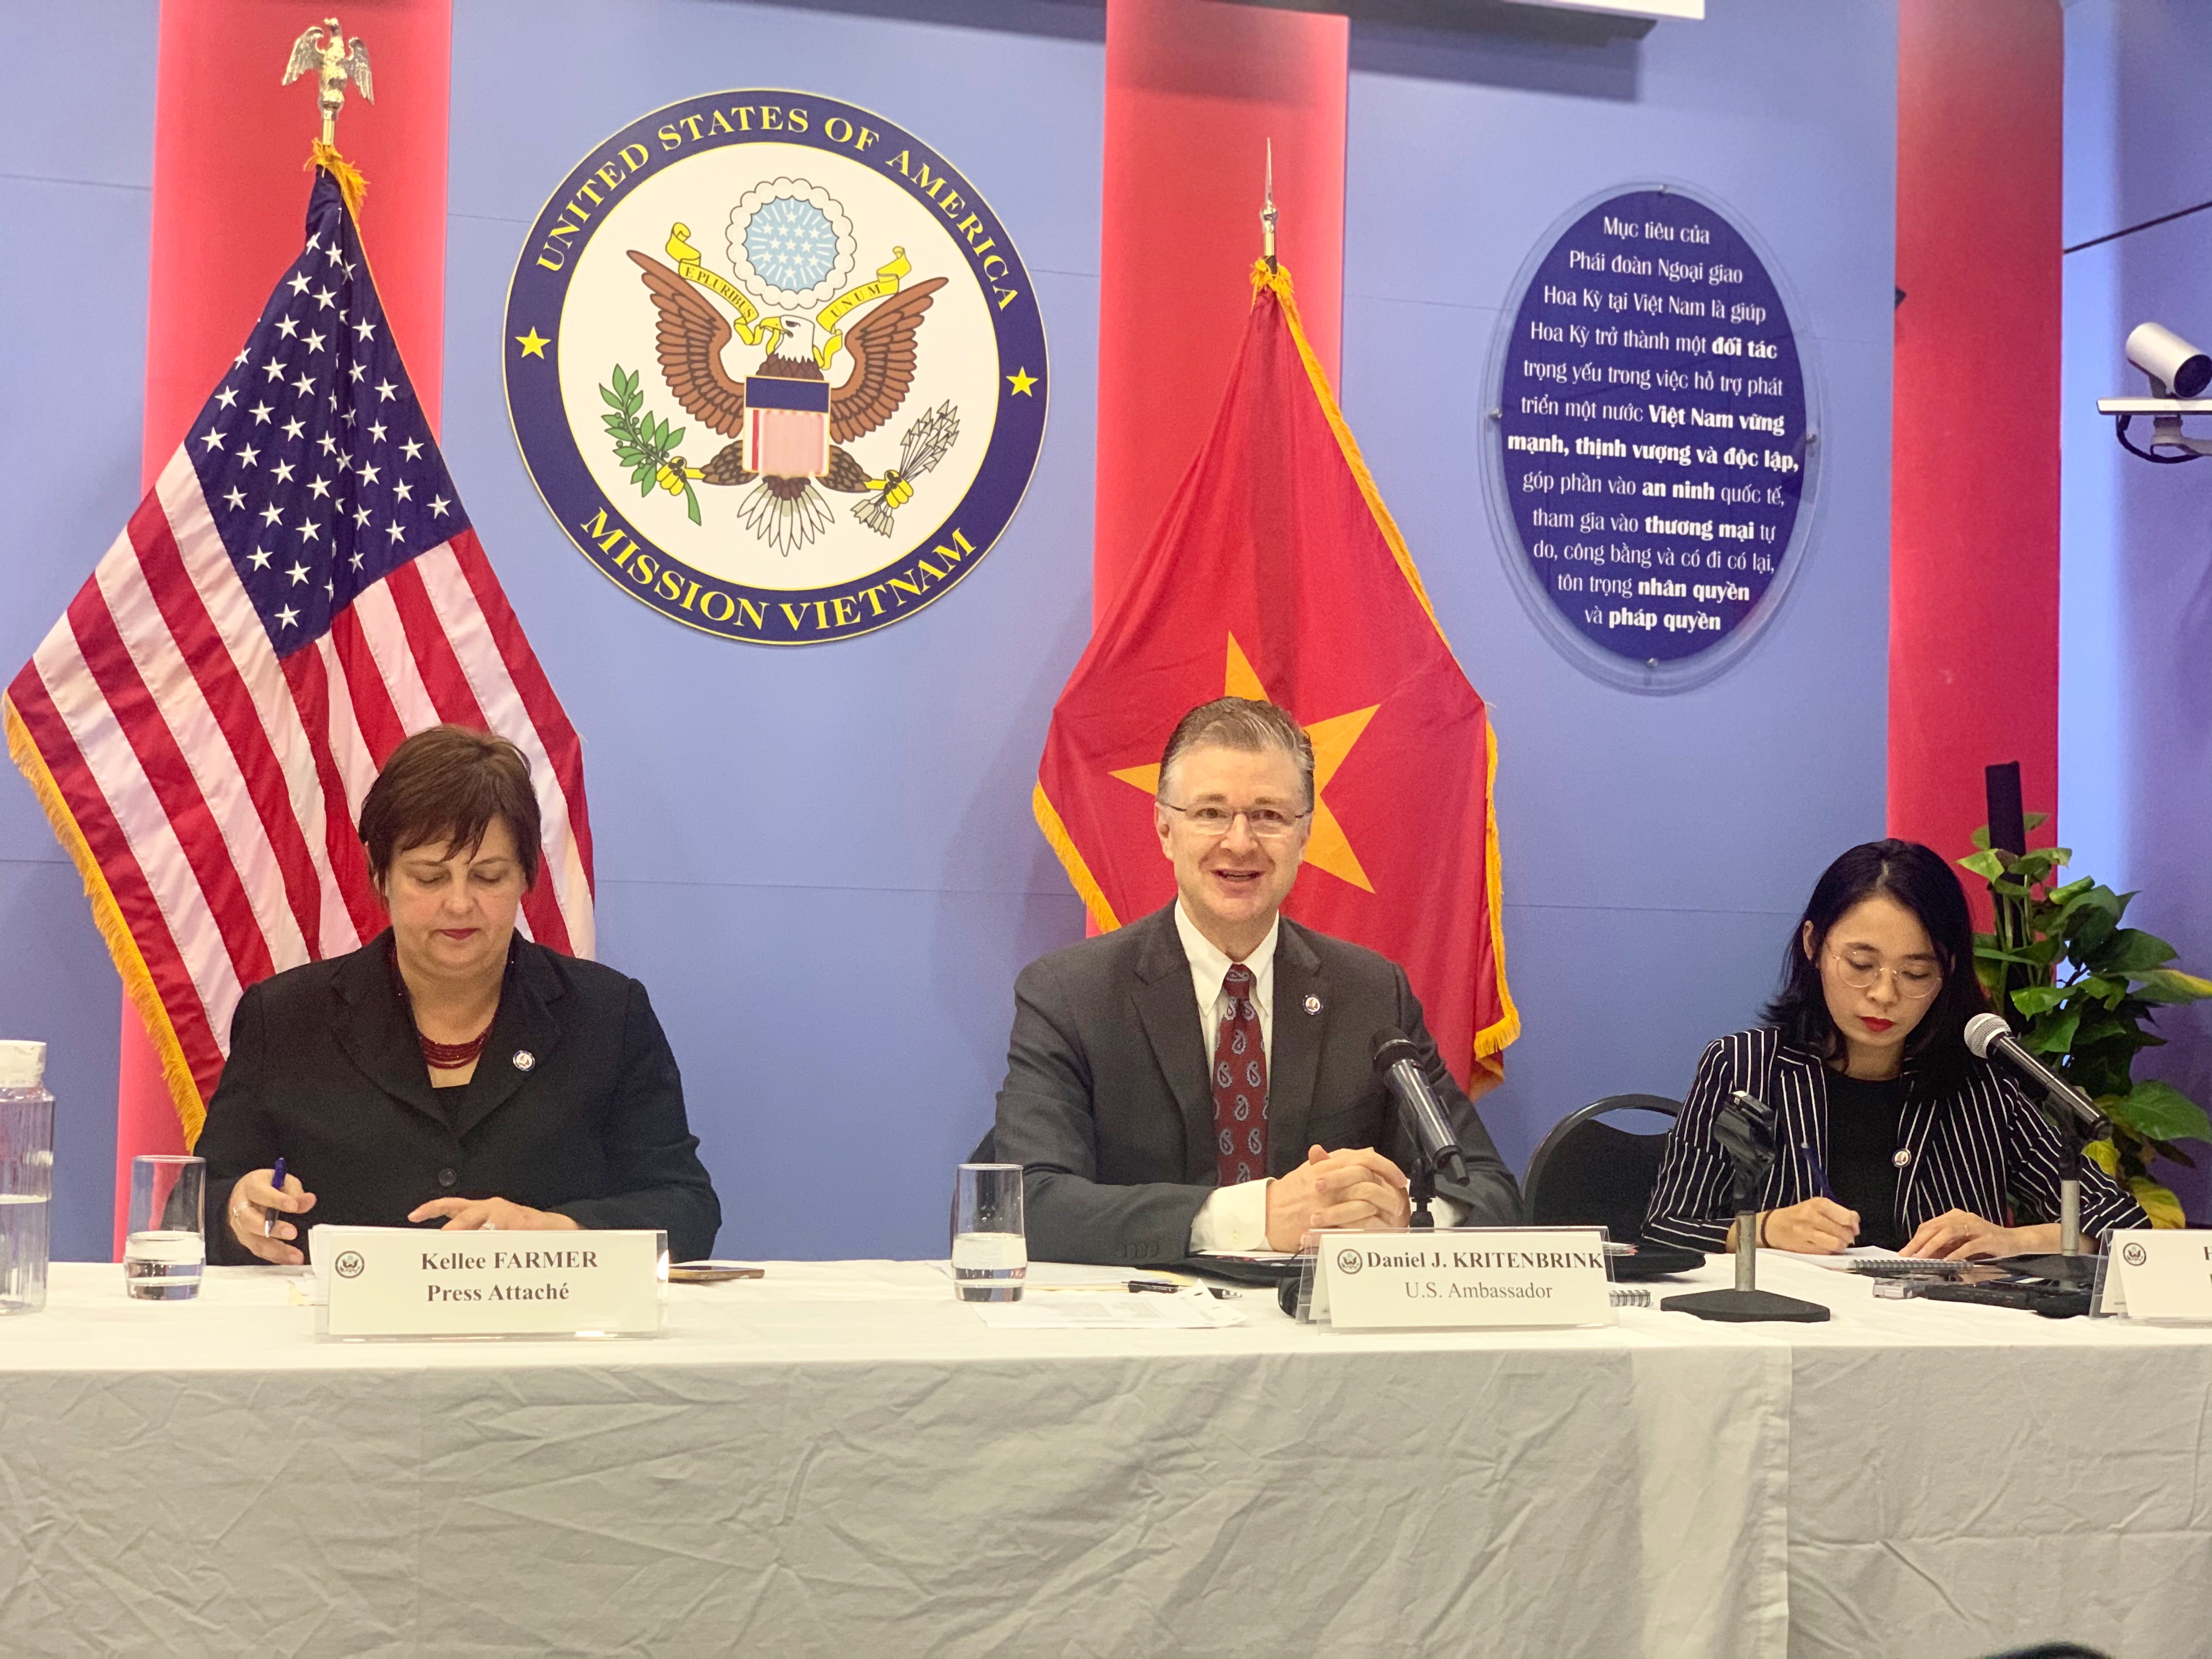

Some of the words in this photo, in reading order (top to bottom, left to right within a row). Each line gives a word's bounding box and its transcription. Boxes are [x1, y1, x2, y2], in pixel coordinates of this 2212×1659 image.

[537, 142, 650, 272] UNITED
[658, 105, 810, 152] STATES
[824, 117, 881, 153] OF
[885, 149, 1019, 311] AMERICA
[1604, 216, 1639, 240] Mục
[1645, 221, 1674, 241] tiêu
[1680, 224, 1709, 245] của
[1570, 250, 1605, 271] Phái
[1611, 254, 1652, 275] đoàn
[1658, 258, 1703, 283] Ngoại
[1708, 264, 1743, 286] giao
[685, 266, 695, 279] E
[696, 270, 755, 319] PLURIBUS
[830, 283, 882, 319] UNUM
[1544, 285, 1577, 306] Hoa
[1583, 287, 1602, 312] Kỳ
[1608, 292, 1628, 313] tại
[1633, 292, 1663, 316] Việt
[1669, 295, 1705, 317] Nam
[1712, 299, 1725, 319] là
[1730, 302, 1766, 325] giúp
[1531, 321, 1564, 342] Hoa
[1570, 324, 1590, 348] Kỳ
[1595, 326, 1618, 346] trở
[1623, 329, 1669, 351] thành
[1676, 335, 1707, 357] một
[1712, 336, 1742, 356] đối
[1747, 340, 1778, 359] tác
[1523, 359, 1567, 383] trọng
[1572, 362, 1601, 385] yếu
[1608, 366, 1651, 390] trong
[1656, 369, 1688, 391] việc
[1695, 370, 1714, 391] hỗ
[1720, 375, 1742, 396] trợ
[1748, 376, 1783, 398] phát
[1521, 393, 1559, 415] triển
[1565, 400, 1597, 421] một
[1602, 403, 1643, 422] nước
[1649, 404, 1686, 428] Việt
[1691, 408, 1734, 428] Nam
[1739, 413, 1785, 437] vững
[1508, 434, 1570, 457] mạnh,
[1575, 436, 1627, 460] thịnh
[1632, 444, 1692, 466] vượng
[1696, 446, 1718, 464] và
[1723, 447, 1759, 470] độc
[1764, 449, 1799, 473] lập,
[1522, 470, 1554, 493] góp
[1560, 472, 1601, 495] phần
[1608, 476, 1637, 495] vào
[1641, 482, 1666, 497] an
[1672, 480, 1715, 500] ninh
[1720, 483, 1761, 506] quốc
[1767, 486, 1784, 507] tế,
[1533, 507, 1574, 528] tham
[1580, 512, 1605, 534] gia
[1610, 513, 1639, 533] vào
[1644, 515, 1714, 541] thương
[1719, 521, 1754, 543] mại
[1759, 524, 1776, 544] tự
[580, 506, 771, 631] MISSION
[778, 527, 977, 632] VIETNAM
[1533, 540, 1558, 561] do,
[1564, 543, 1605, 566] công
[1611, 542, 1652, 569] bằng
[1657, 547, 1675, 566] và
[1681, 549, 1700, 567] có
[1706, 550, 1721, 568] đi
[1727, 551, 1747, 570] có
[1753, 552, 1774, 574] lại,
[1558, 573, 1583, 591] tôn
[1589, 575, 1633, 599] trọng
[1638, 577, 1687, 597] nhân
[1692, 581, 1750, 603] quyền
[1584, 605, 1603, 624] và
[1609, 607, 1658, 631] pháp
[1663, 611, 1721, 633] quyền
[421, 1252, 486, 1271] Kellee
[494, 1250, 599, 1269] FARMER
[1367, 1251, 1426, 1269] Daniel
[1431, 1251, 1447, 1269] J.
[1454, 1251, 1604, 1269] KRITENBRINK
[427, 1284, 482, 1302] Press
[488, 1282, 569, 1301] Attaché
[1404, 1282, 1443, 1299] U.S.
[1448, 1282, 1553, 1299] Ambassador
